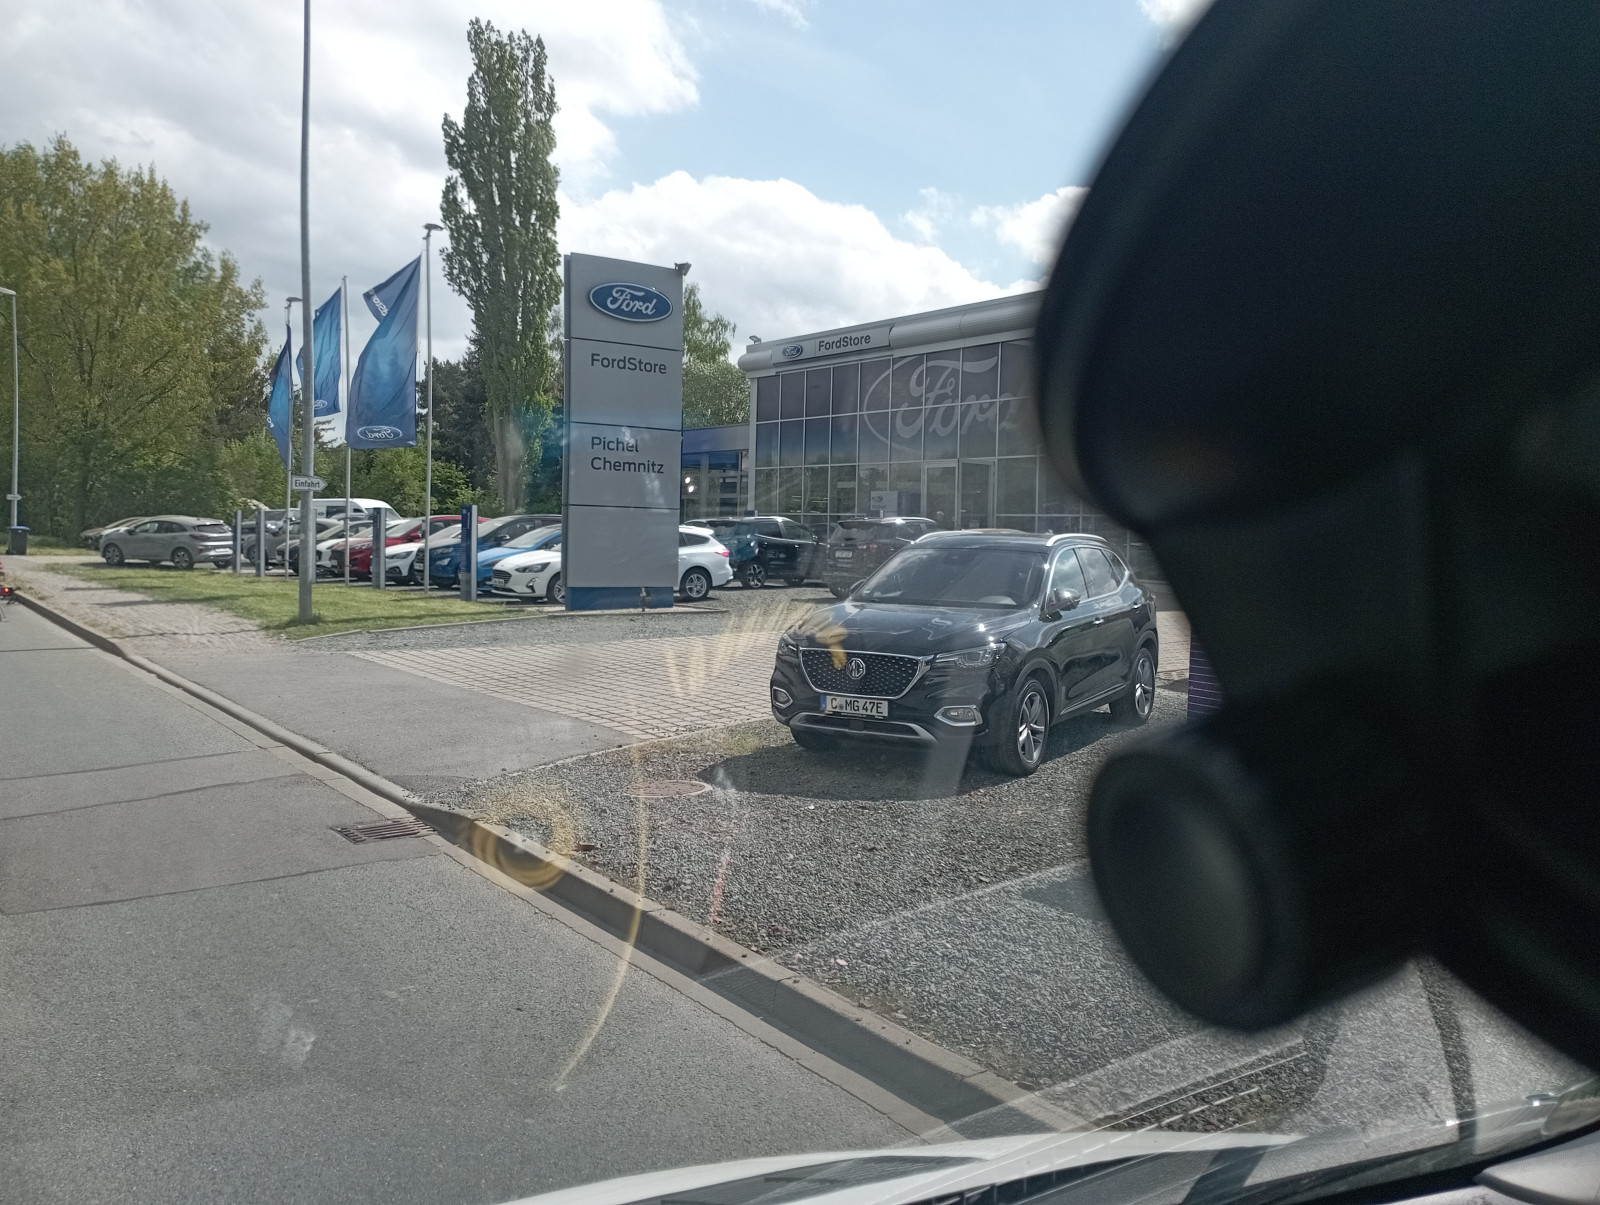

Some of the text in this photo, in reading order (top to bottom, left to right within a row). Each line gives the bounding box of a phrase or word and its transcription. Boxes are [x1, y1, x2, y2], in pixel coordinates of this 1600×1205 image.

[606, 286, 657, 316] Ford
[818, 334, 871, 352] FordStore
[590, 352, 667, 375] FordStore
[591, 436, 640, 453] Pichel
[590, 456, 665, 474] Chemnitz
[294, 479, 320, 489] Einfahrt
[844, 699, 860, 712] MG
[861, 700, 884, 715] 47E
